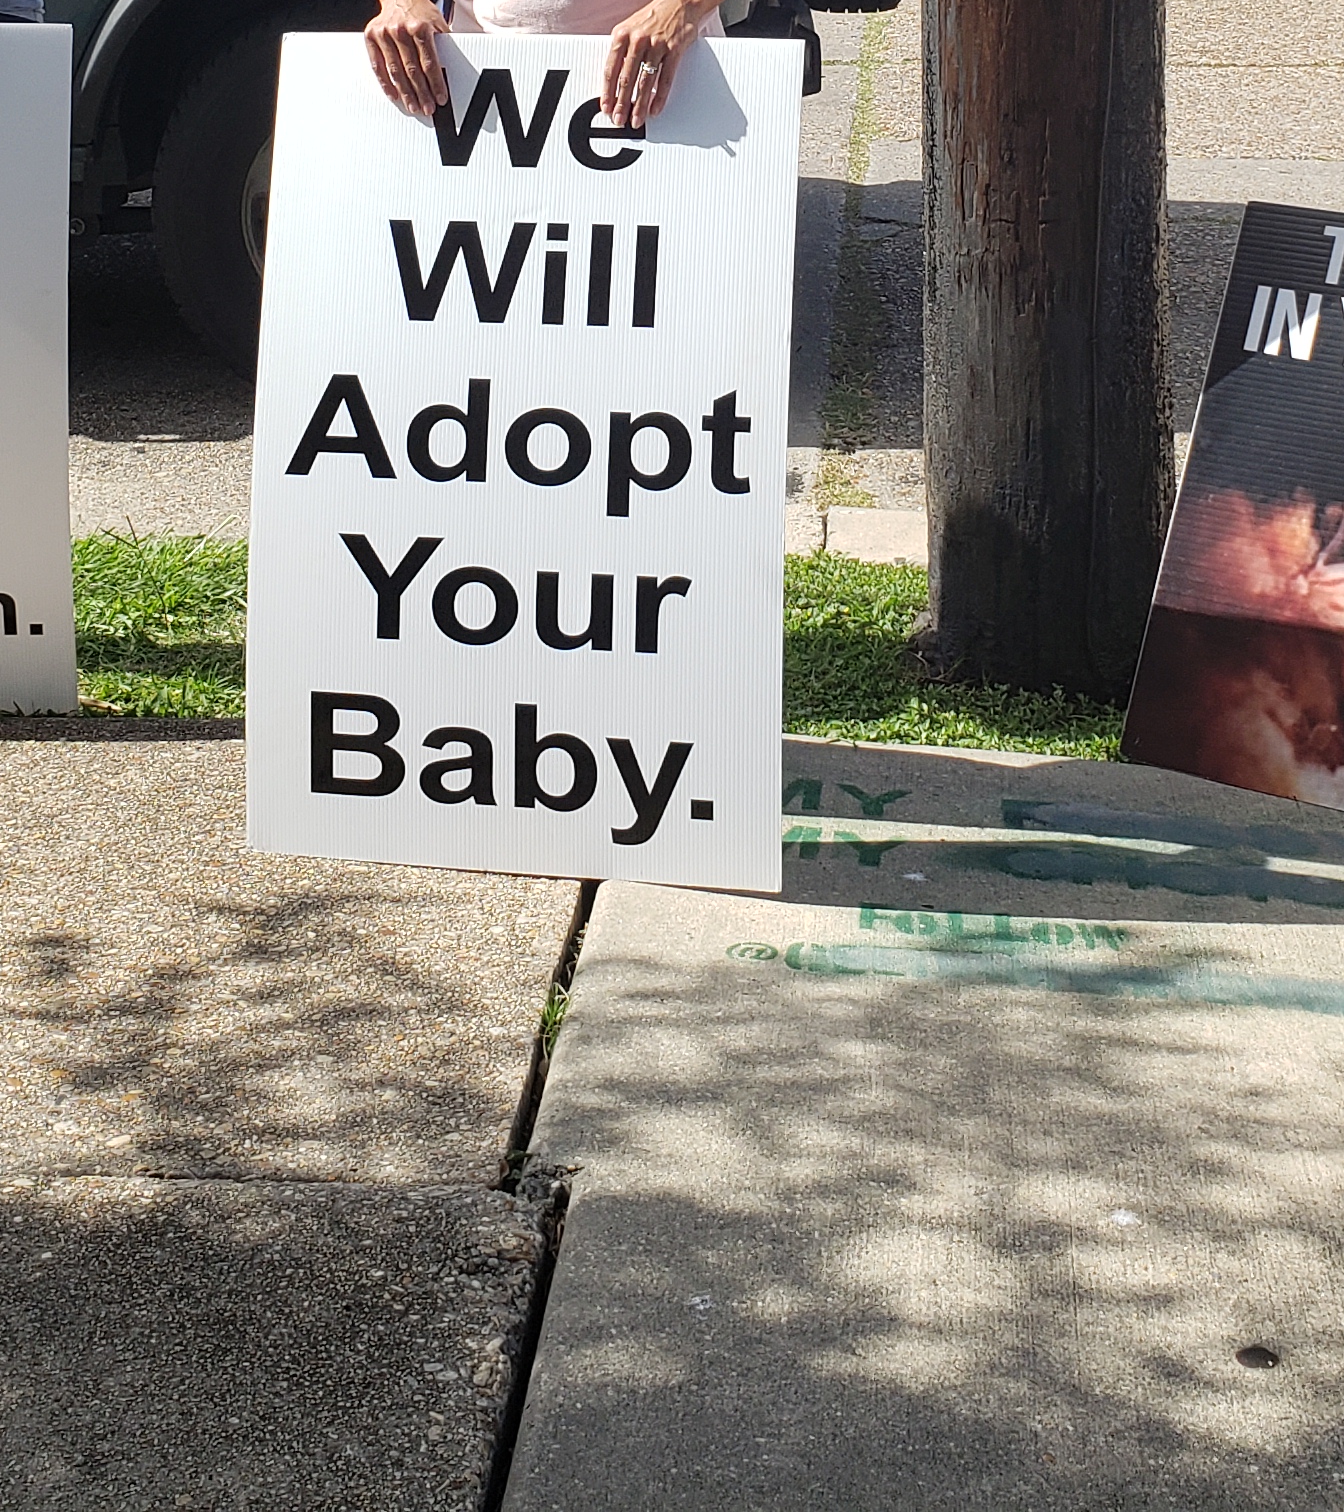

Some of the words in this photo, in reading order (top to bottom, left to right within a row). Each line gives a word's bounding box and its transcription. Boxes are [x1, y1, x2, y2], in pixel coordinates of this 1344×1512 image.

[433, 67, 646, 171] We
[390, 220, 659, 327] Will
[1244, 286, 1322, 360] IN
[285, 374, 751, 517] Adopt
[340, 534, 691, 653] Your
[311, 691, 713, 845] Baby.
